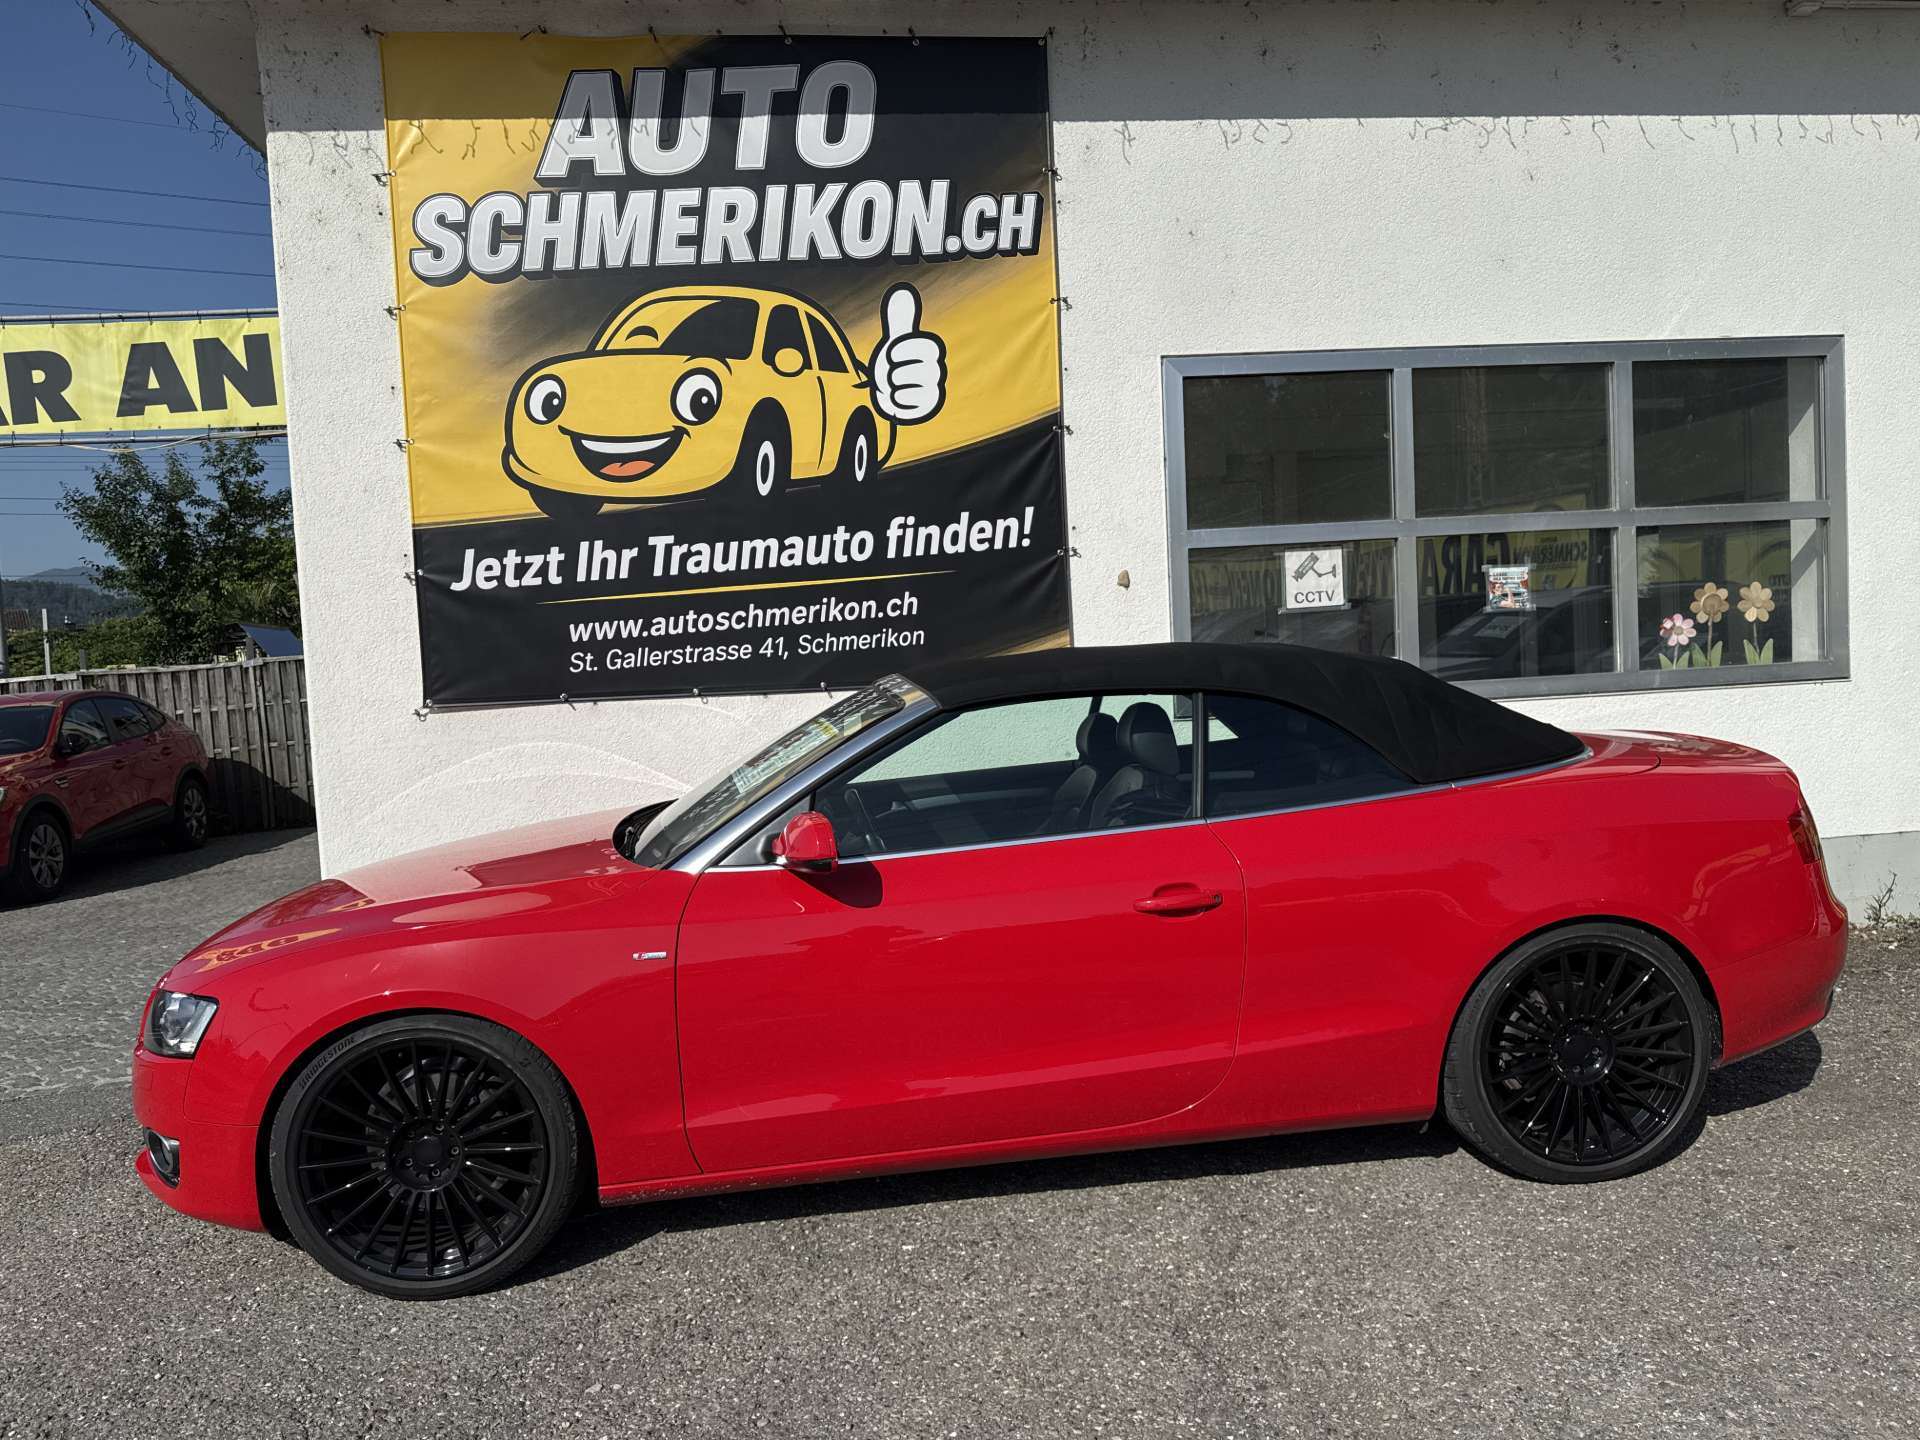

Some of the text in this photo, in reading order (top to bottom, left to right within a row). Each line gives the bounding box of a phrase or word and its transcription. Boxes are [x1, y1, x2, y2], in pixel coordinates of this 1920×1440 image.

[535, 59, 877, 179] AUTO
[409, 179, 1041, 280] SCHMERIKON.CH
[0, 333, 278, 426] R AN
[449, 506, 1035, 592] Jetzt Ihr Traumauto finden!
[568, 591, 919, 643] www.autoschmerikon.ch
[1294, 590, 1336, 604] CCTV
[569, 628, 926, 673] St. Gallerstrasse 41, Schmerikon
